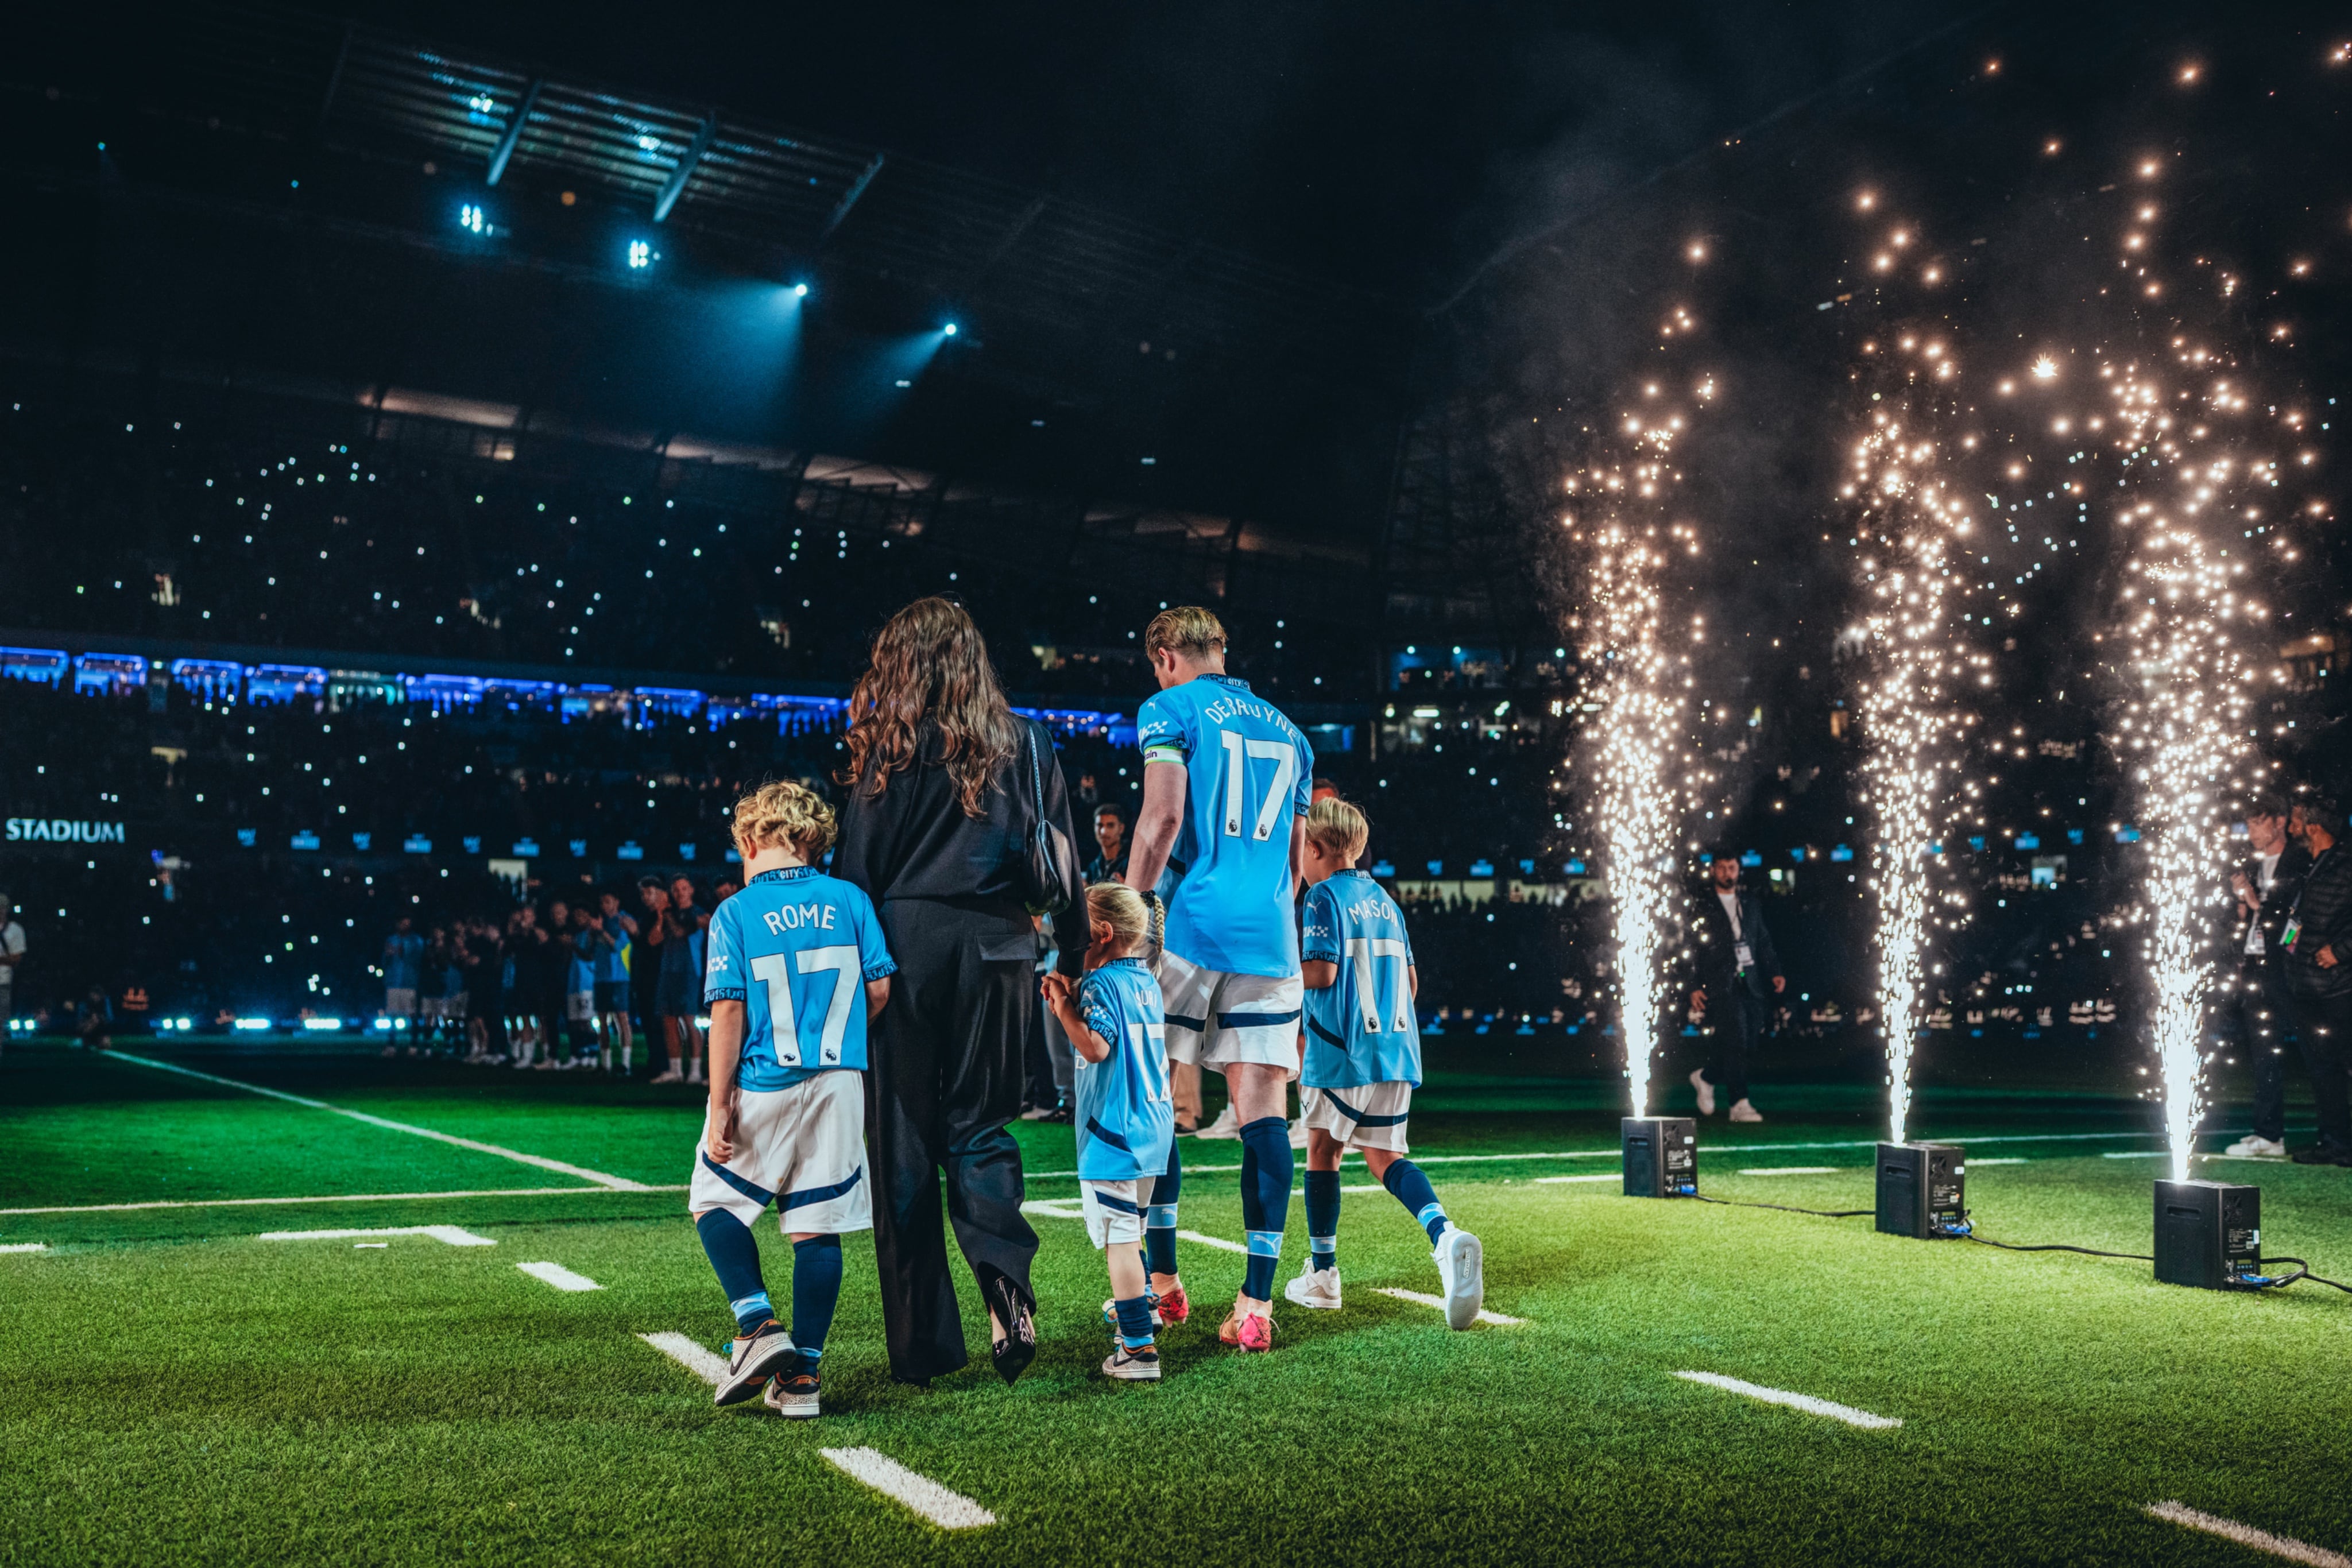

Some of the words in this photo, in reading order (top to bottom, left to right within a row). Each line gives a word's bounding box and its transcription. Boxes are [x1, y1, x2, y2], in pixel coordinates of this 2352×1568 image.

[1204, 696, 1299, 742] DEBRUYNE
[1220, 729, 1294, 842] 17
[6, 818, 125, 843] STADIUM
[780, 869, 800, 880] CITY
[763, 904, 836, 936] ROME
[1348, 900, 1398, 927] MASON
[749, 945, 861, 1067] 17
[1345, 938, 1407, 1034] 17
[1128, 1023, 1170, 1102] 17
